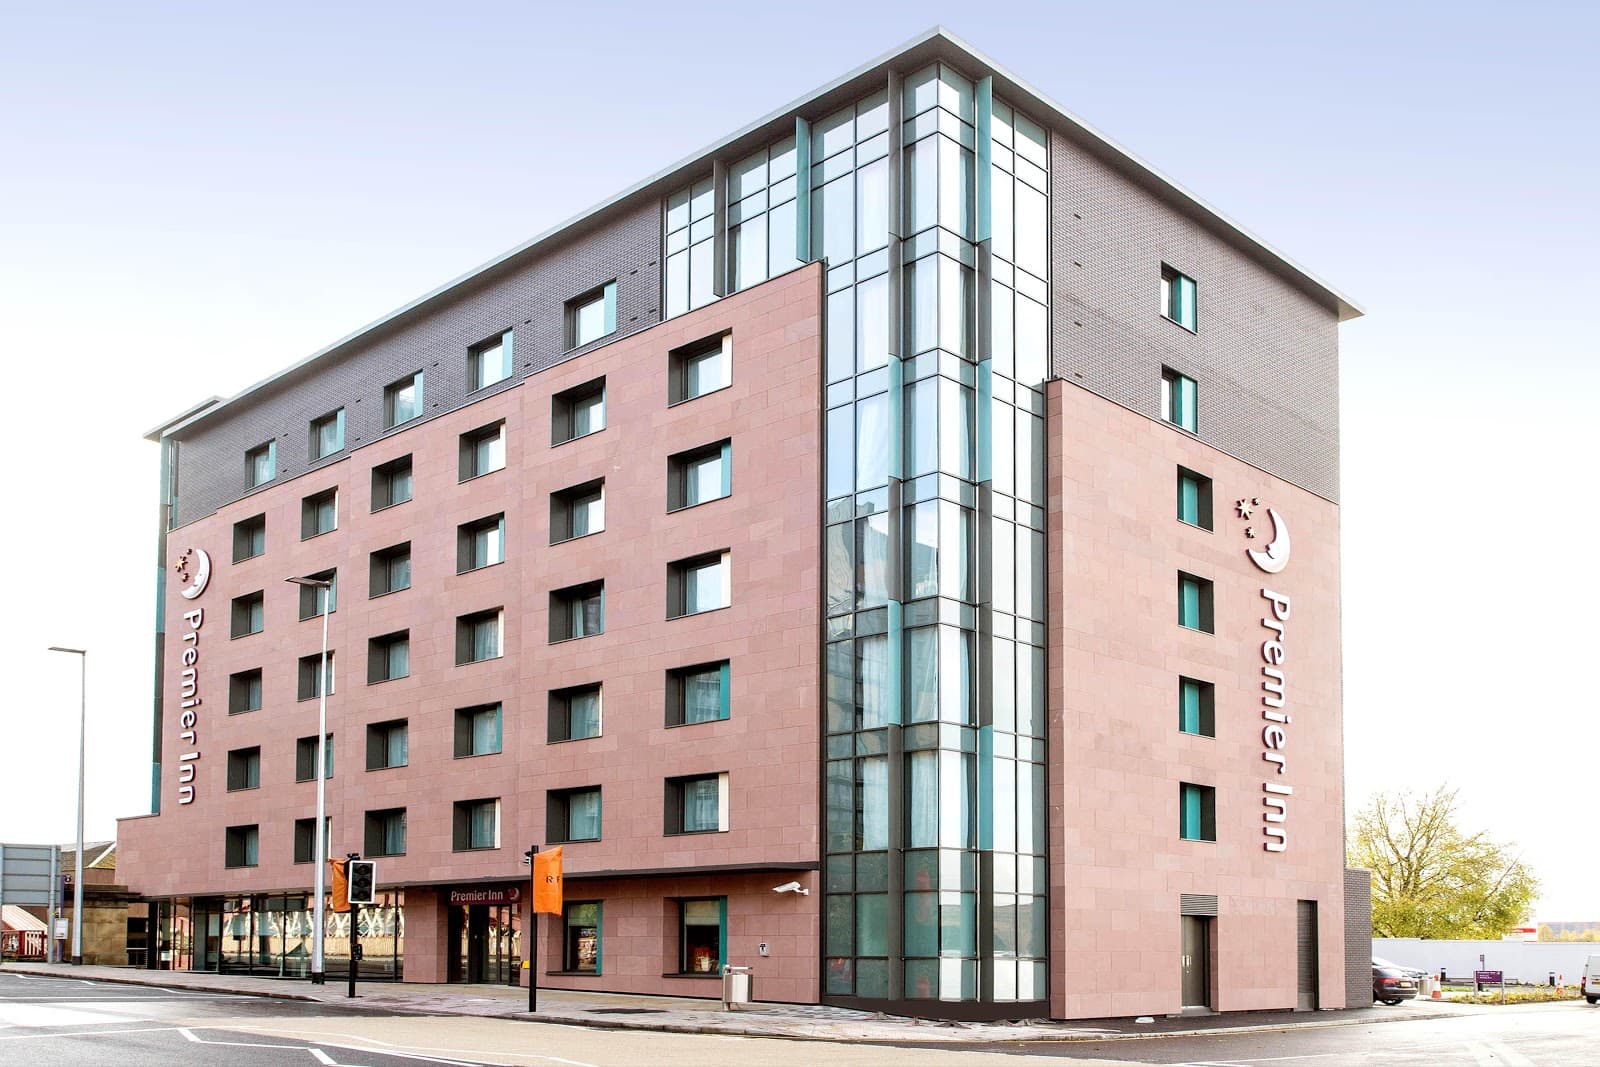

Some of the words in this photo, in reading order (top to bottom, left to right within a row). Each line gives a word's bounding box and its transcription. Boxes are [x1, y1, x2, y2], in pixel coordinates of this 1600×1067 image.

[181, 607, 204, 745] Premier
[1260, 588, 1292, 774] Premier
[179, 752, 201, 805] Inn
[1262, 782, 1293, 853] Inn
[450, 890, 487, 902] Premier
[488, 889, 504, 901] Inn
